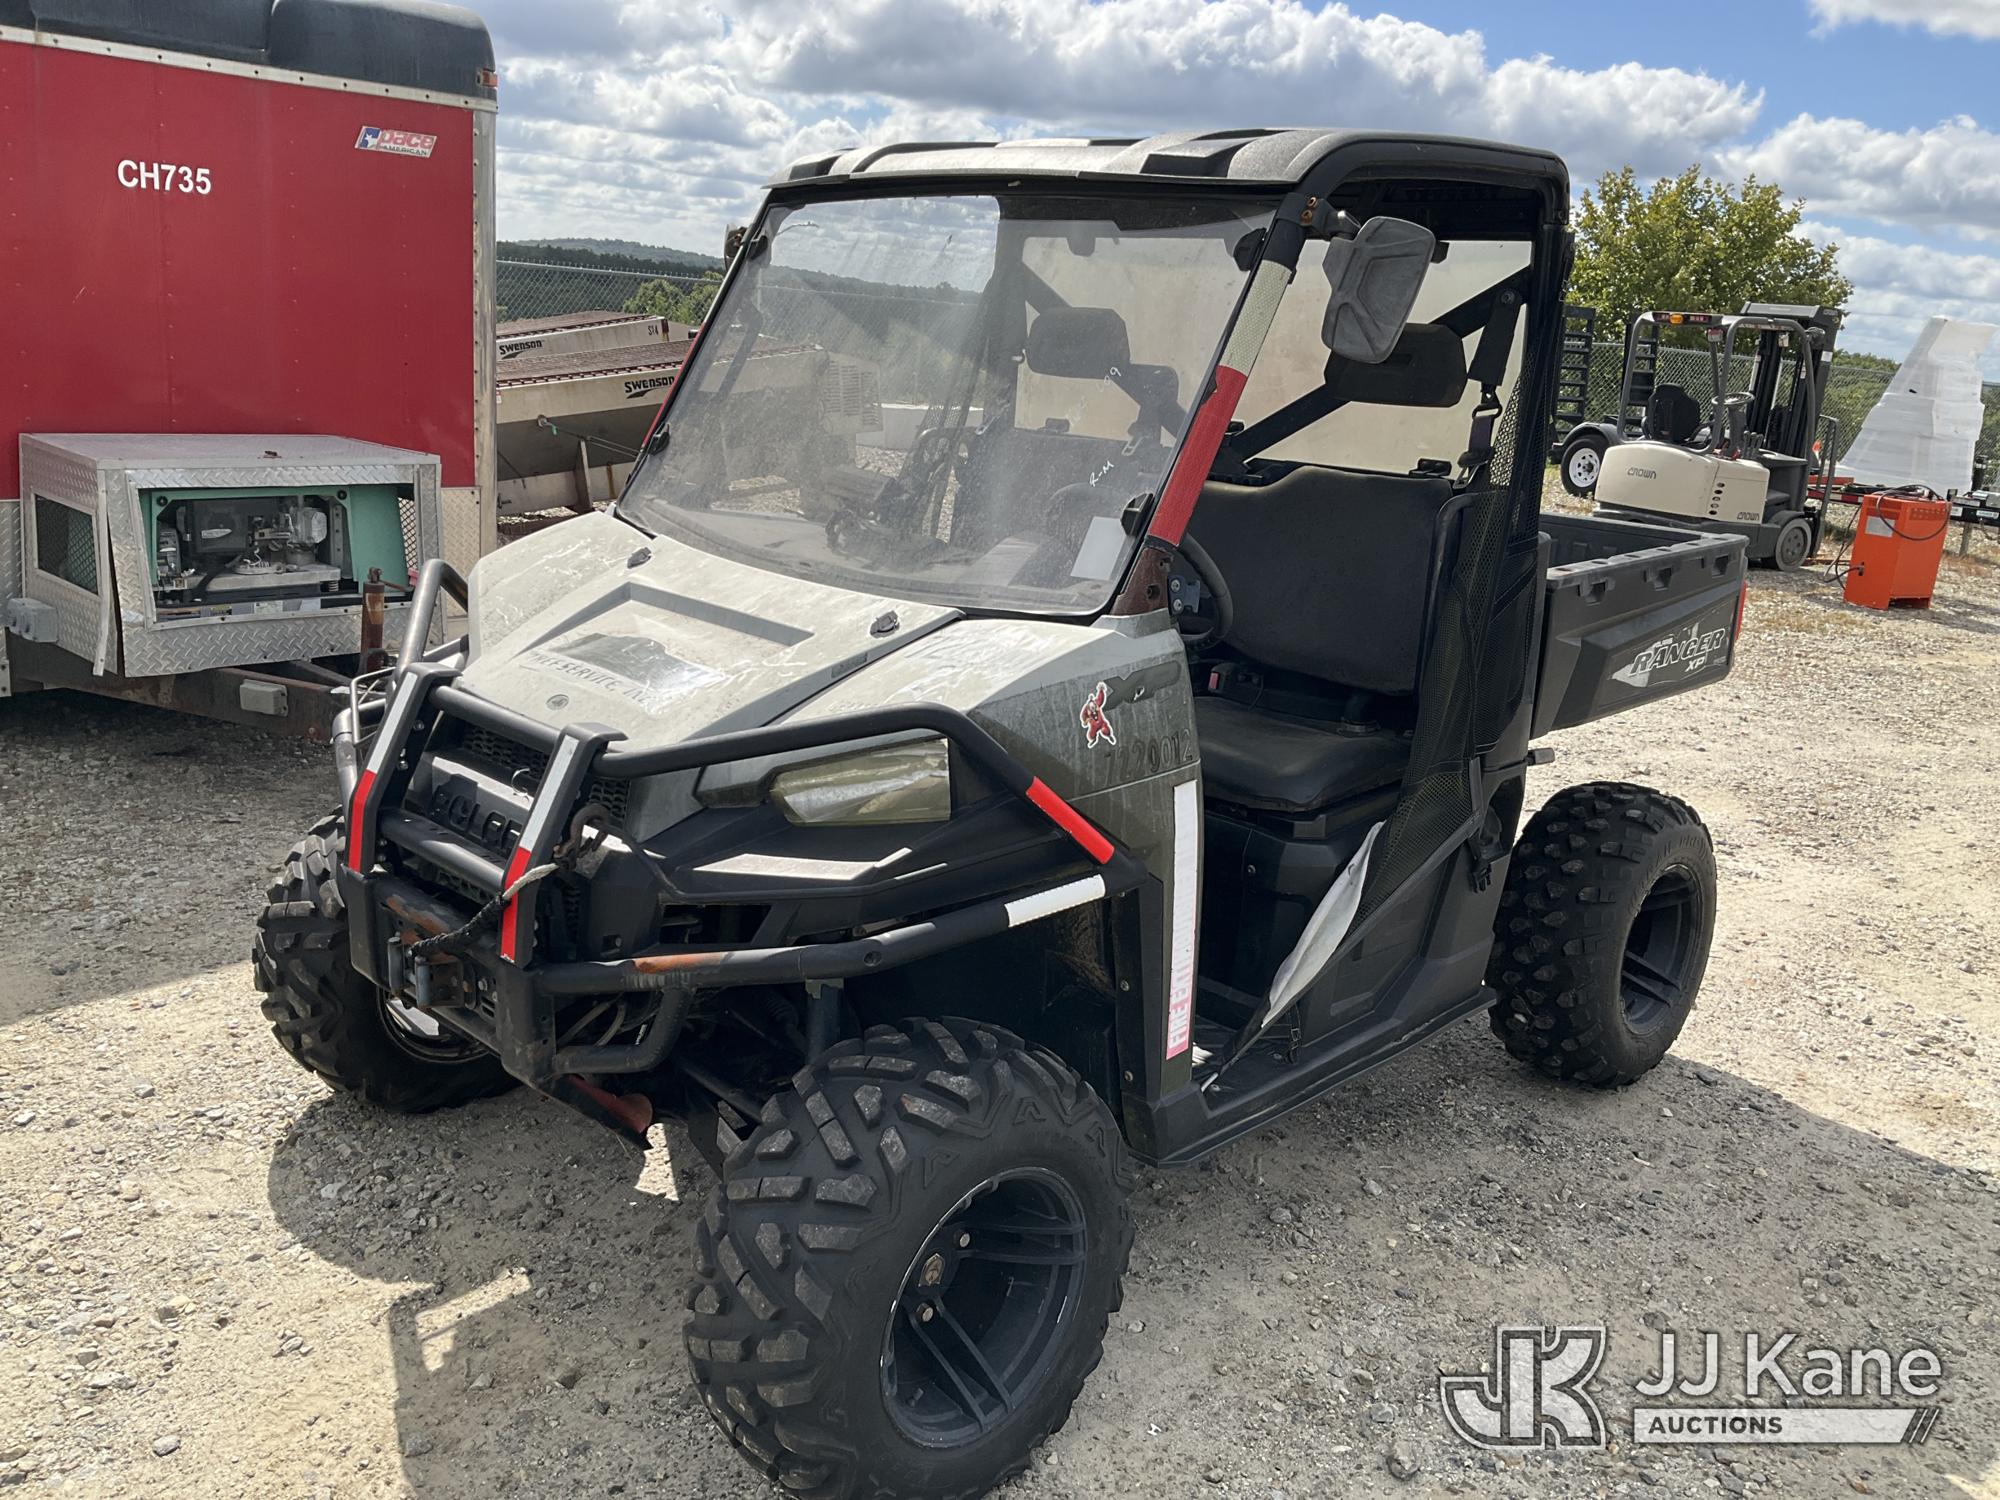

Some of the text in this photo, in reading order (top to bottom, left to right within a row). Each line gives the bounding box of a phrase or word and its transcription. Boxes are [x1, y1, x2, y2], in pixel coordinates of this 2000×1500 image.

[382, 144, 427, 155] AMERICAN
[117, 159, 211, 195] CH735
[1627, 467, 1657, 480] CROWN
[1736, 511, 1760, 521] CROWN
[1627, 627, 1726, 677] RANGER
[1684, 655, 1706, 673] XP
[1168, 1001, 1190, 1048] FIRE
